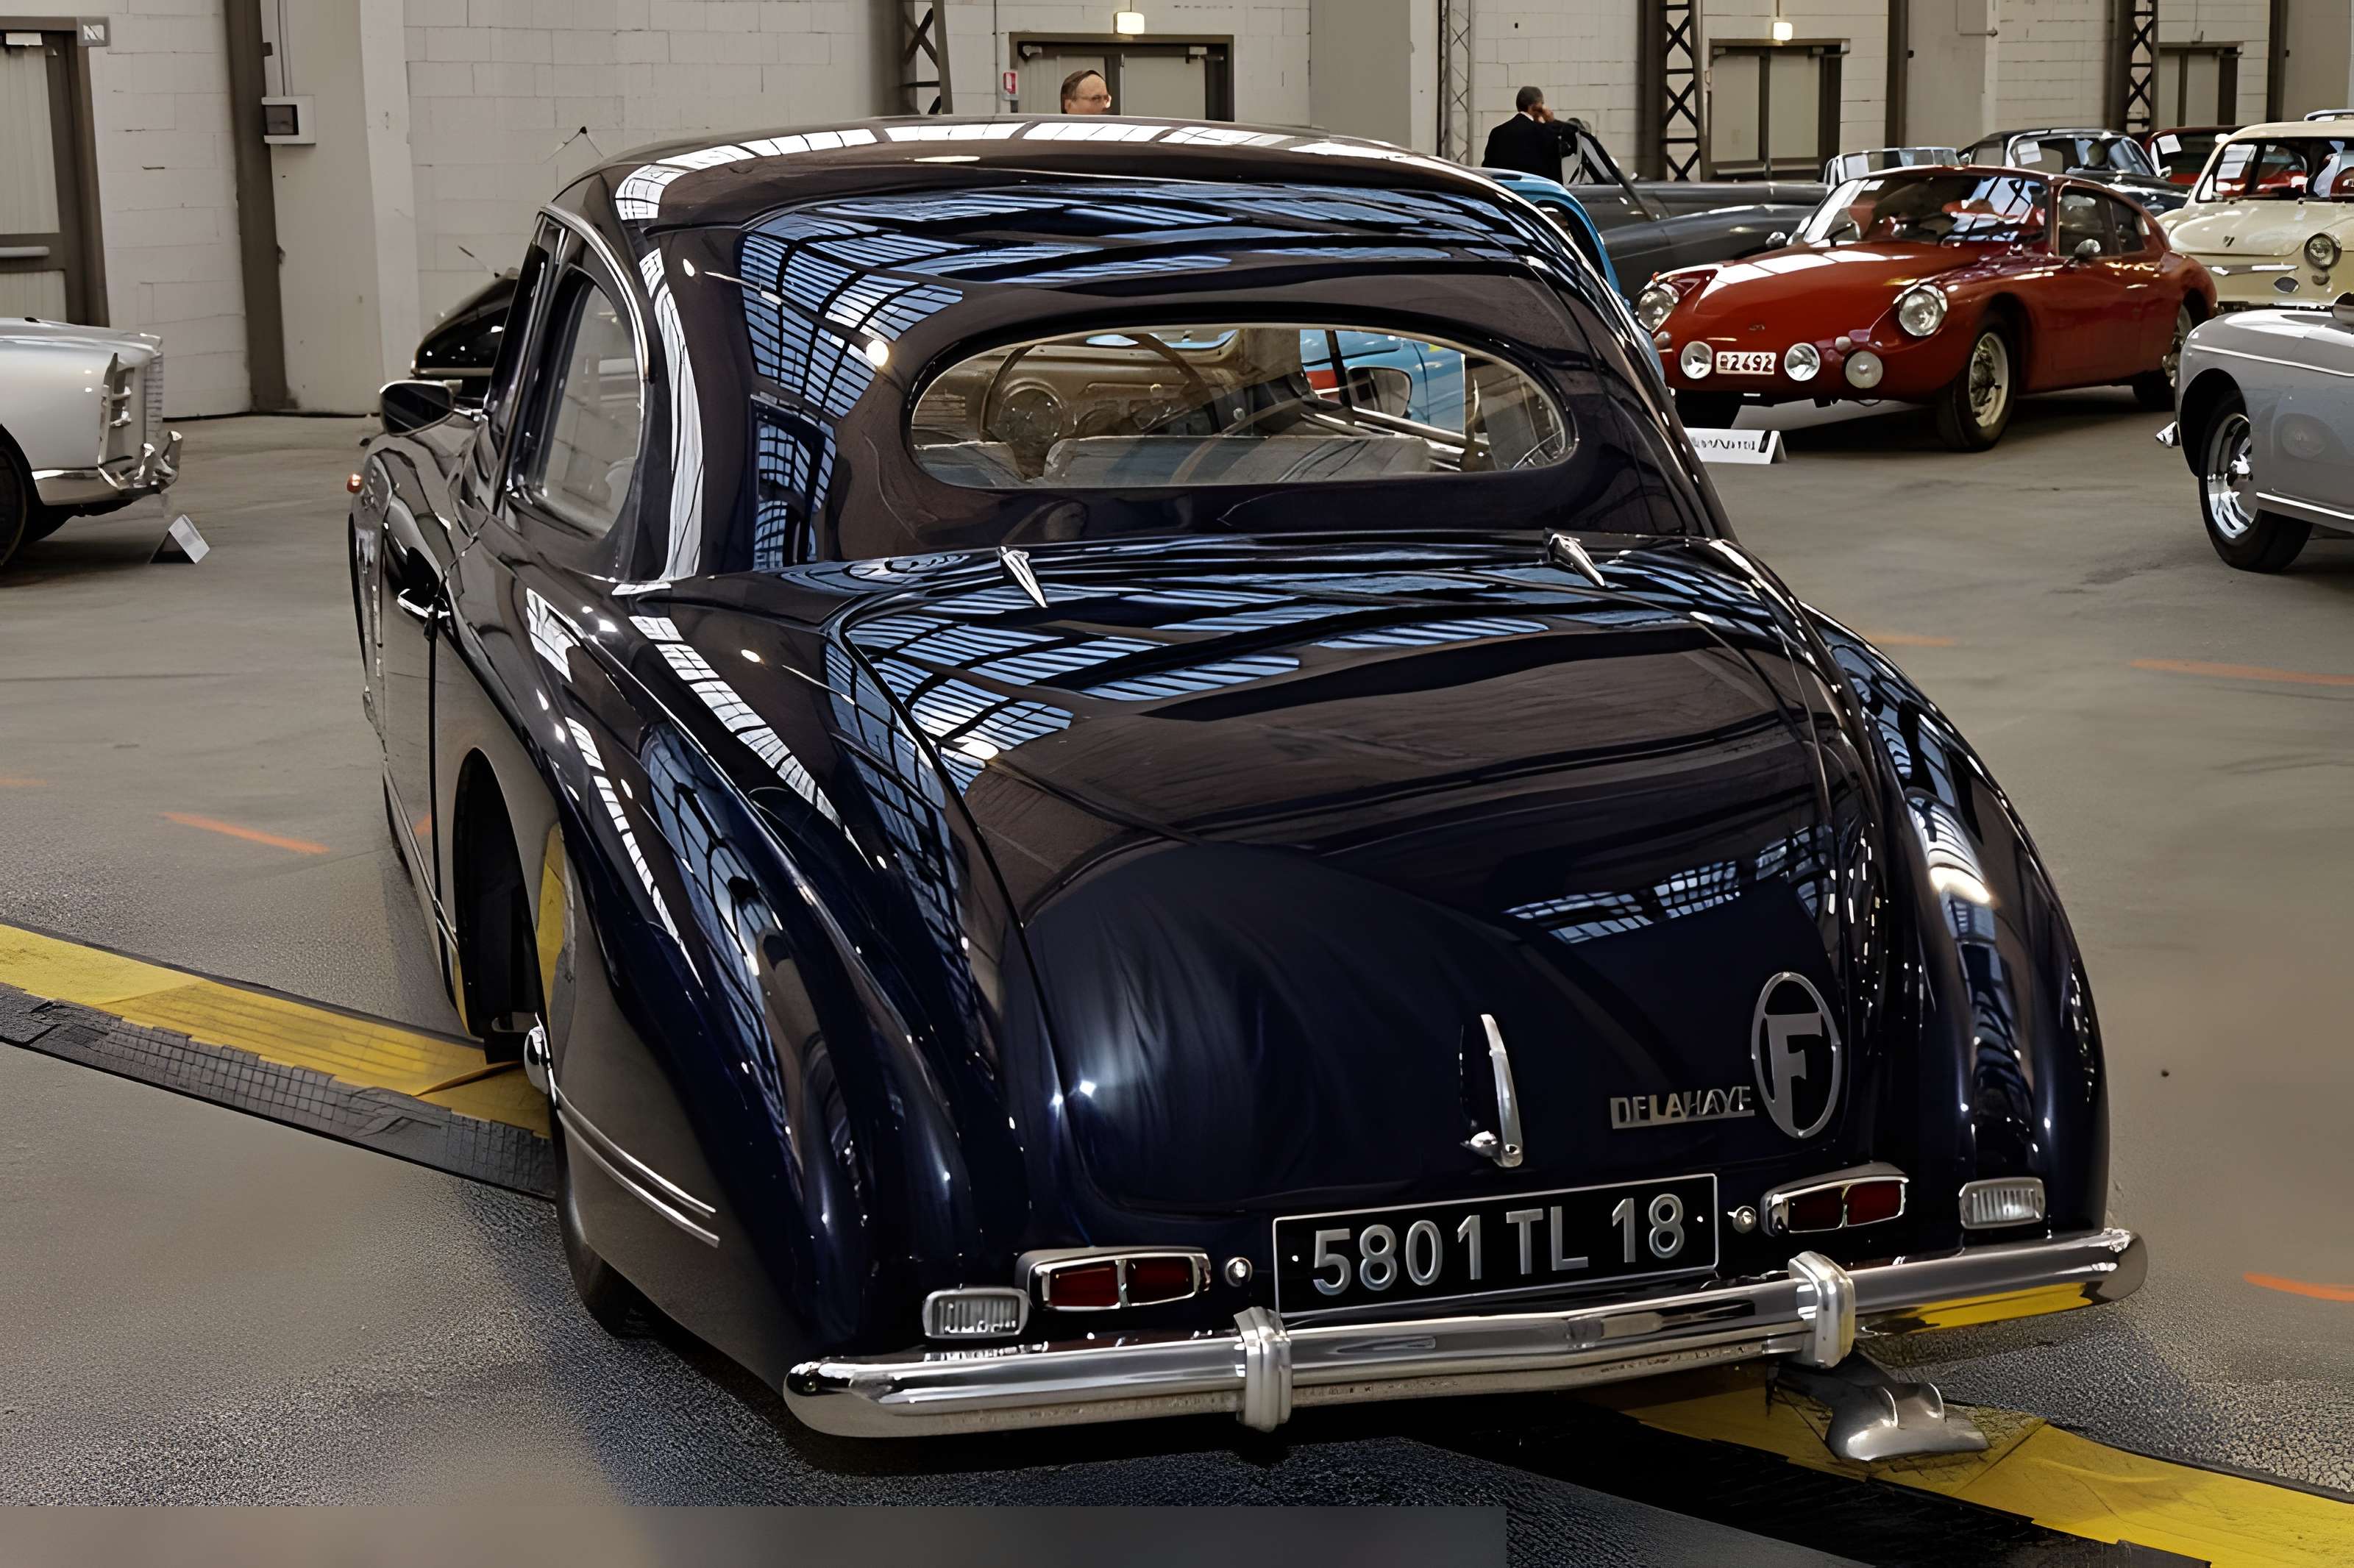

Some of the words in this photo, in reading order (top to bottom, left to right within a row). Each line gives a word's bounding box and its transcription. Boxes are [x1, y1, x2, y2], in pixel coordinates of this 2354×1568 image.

[1610, 1086, 1752, 1125] DELAHAYE
[1764, 1009, 1823, 1138] F
[1312, 1214, 1482, 1296] 5801
[1505, 1205, 1589, 1275] TL
[1611, 1193, 1685, 1264] 18
